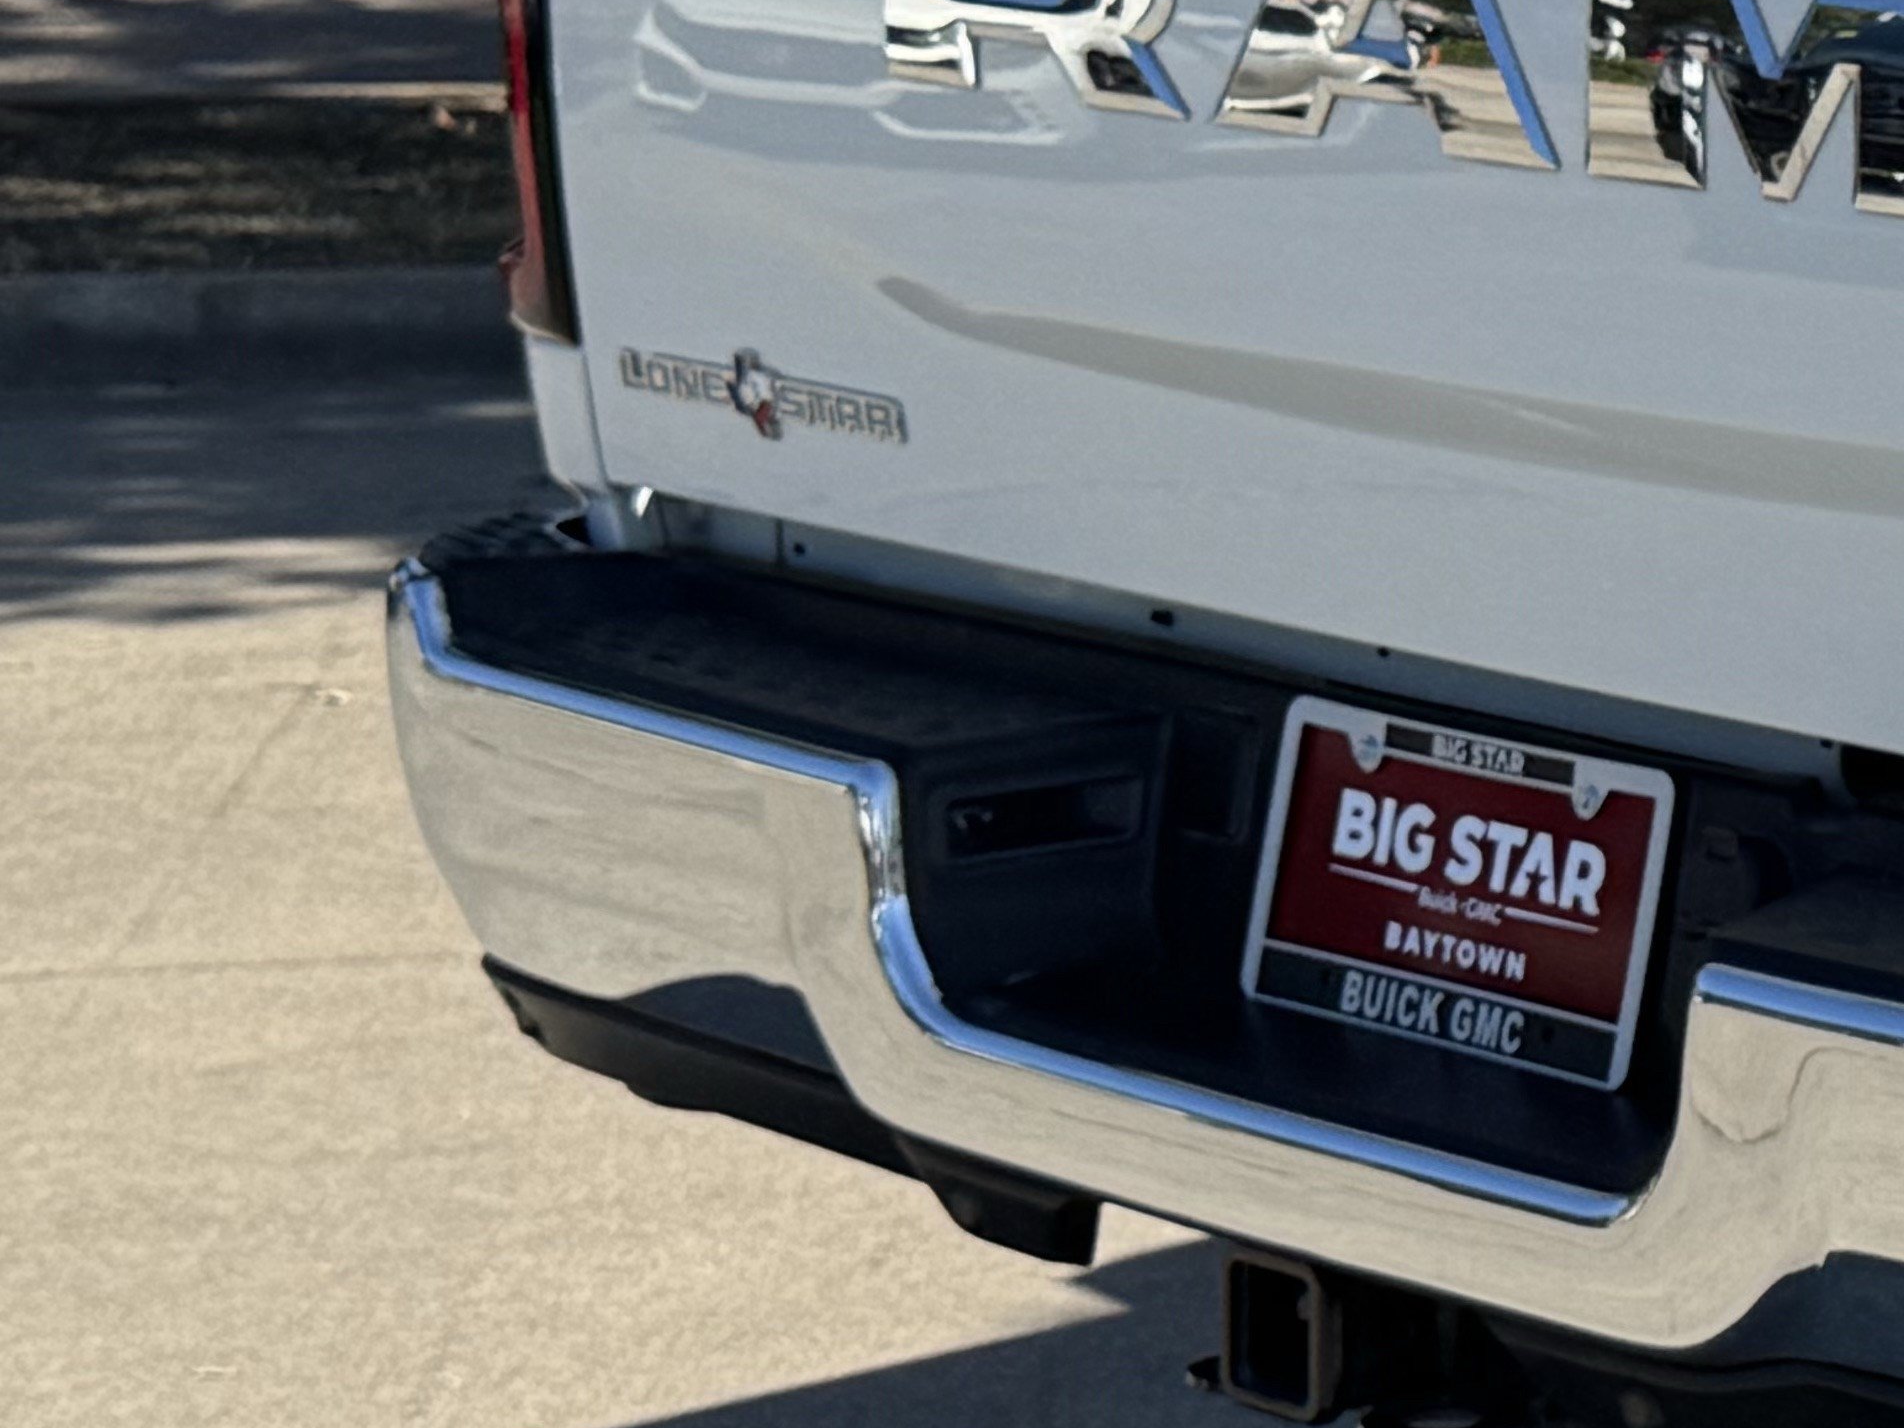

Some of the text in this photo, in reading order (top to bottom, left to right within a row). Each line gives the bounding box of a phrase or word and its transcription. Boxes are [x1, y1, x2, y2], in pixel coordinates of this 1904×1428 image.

[619, 346, 909, 444] LONE STAR
[1431, 732, 1525, 777] BIG STAR
[1332, 787, 1606, 916] BIG STAR
[1383, 920, 1527, 982] BAYTOWN
[1341, 969, 1525, 1054] BUICK GMC
